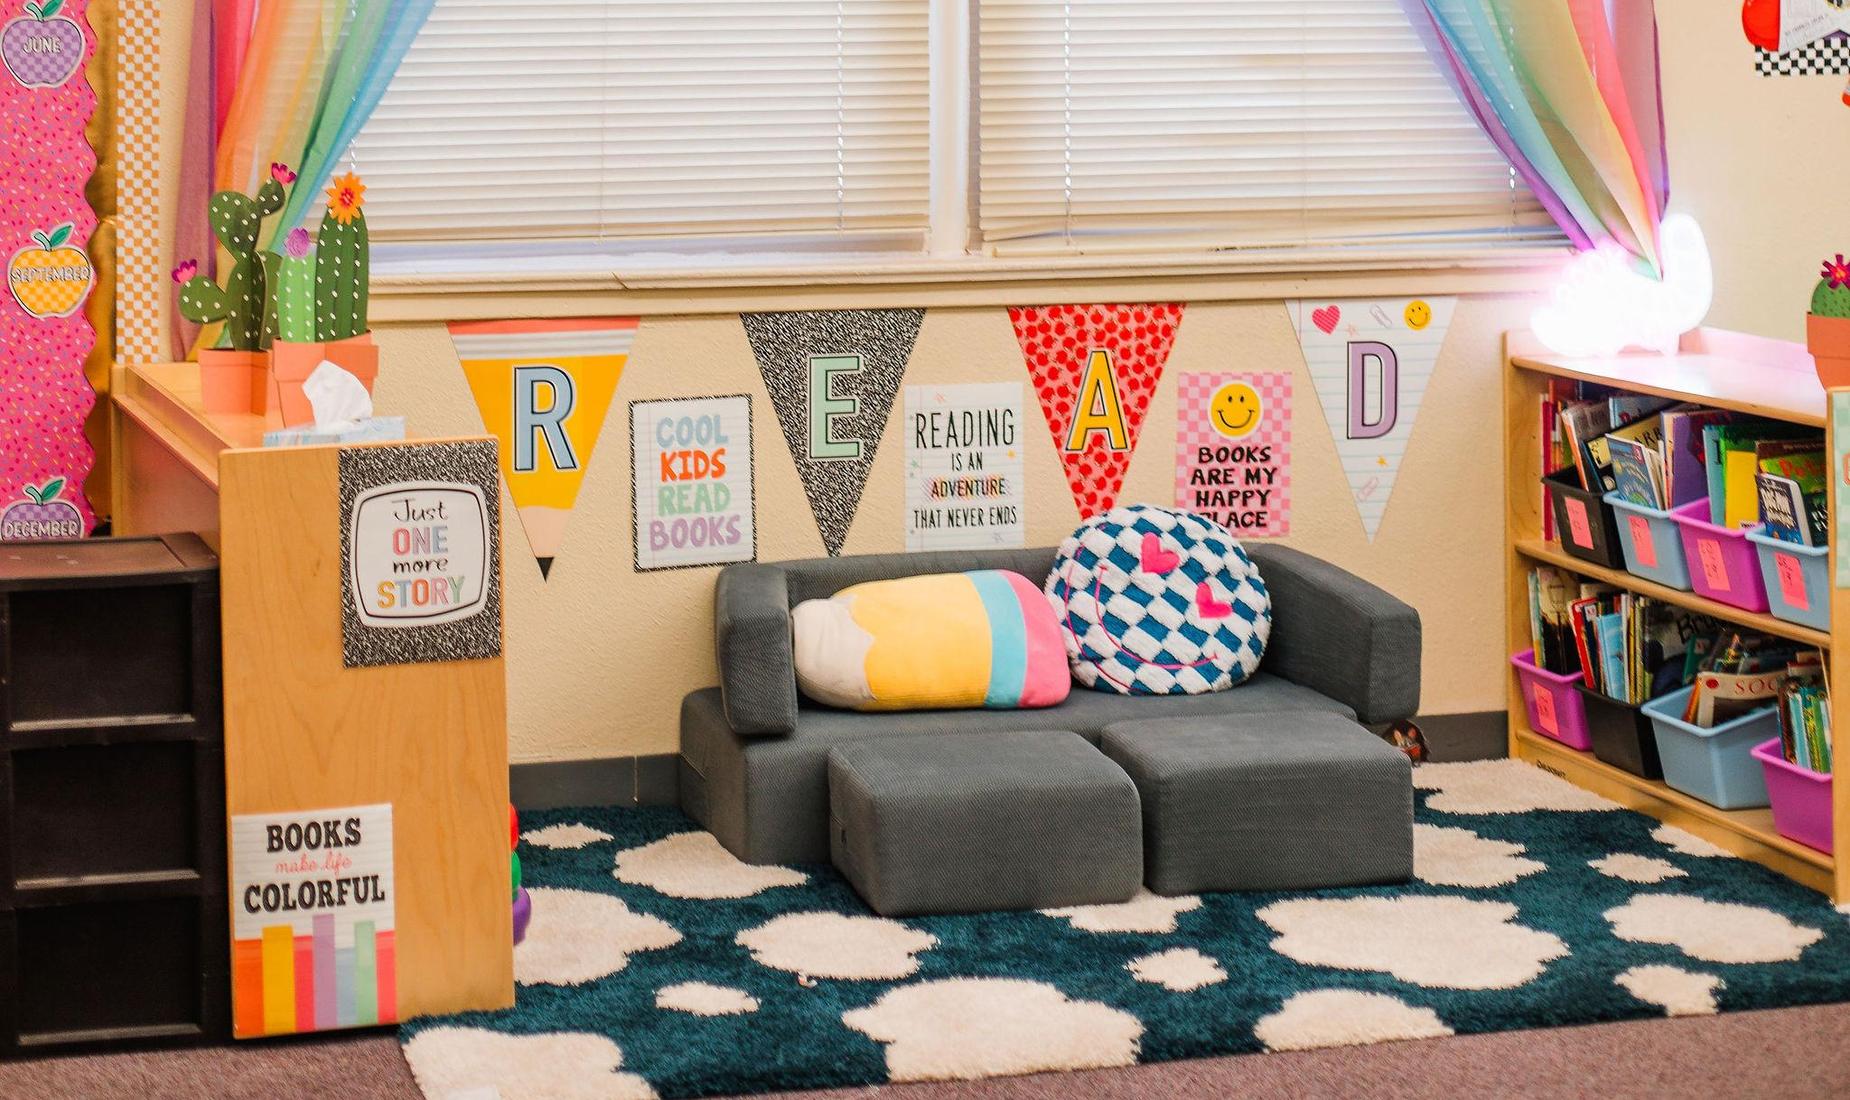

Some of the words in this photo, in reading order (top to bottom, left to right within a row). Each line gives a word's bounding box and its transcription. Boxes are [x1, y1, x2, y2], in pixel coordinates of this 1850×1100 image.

[23, 34, 62, 54] JUNE
[10, 266, 90, 282] SEPTEMBER
[655, 414, 728, 449] COOL
[915, 408, 1014, 449] READING
[660, 448, 726, 482] KIDS
[951, 452, 962, 472] IS
[968, 451, 983, 471] AN
[1198, 446, 1272, 464] BOOKS
[931, 478, 1006, 498] ADVENTURE
[1190, 468, 1235, 485] ARE
[1245, 467, 1278, 486] MY
[391, 498, 449, 522] Just
[657, 482, 731, 517] READ
[1195, 489, 1272, 507] HAPPY
[4, 520, 78, 538] DECEMBER
[914, 509, 942, 529] THAT
[947, 507, 985, 528] NEVER
[989, 505, 1017, 526] ENDS
[392, 525, 449, 556] ONE
[650, 514, 742, 551] BOOKS
[393, 558, 448, 574] more
[376, 575, 465, 609] STORY
[266, 817, 361, 852] BOOKS
[275, 852, 317, 873] make
[321, 848, 353, 880] life
[244, 874, 385, 914] COLORFUL
